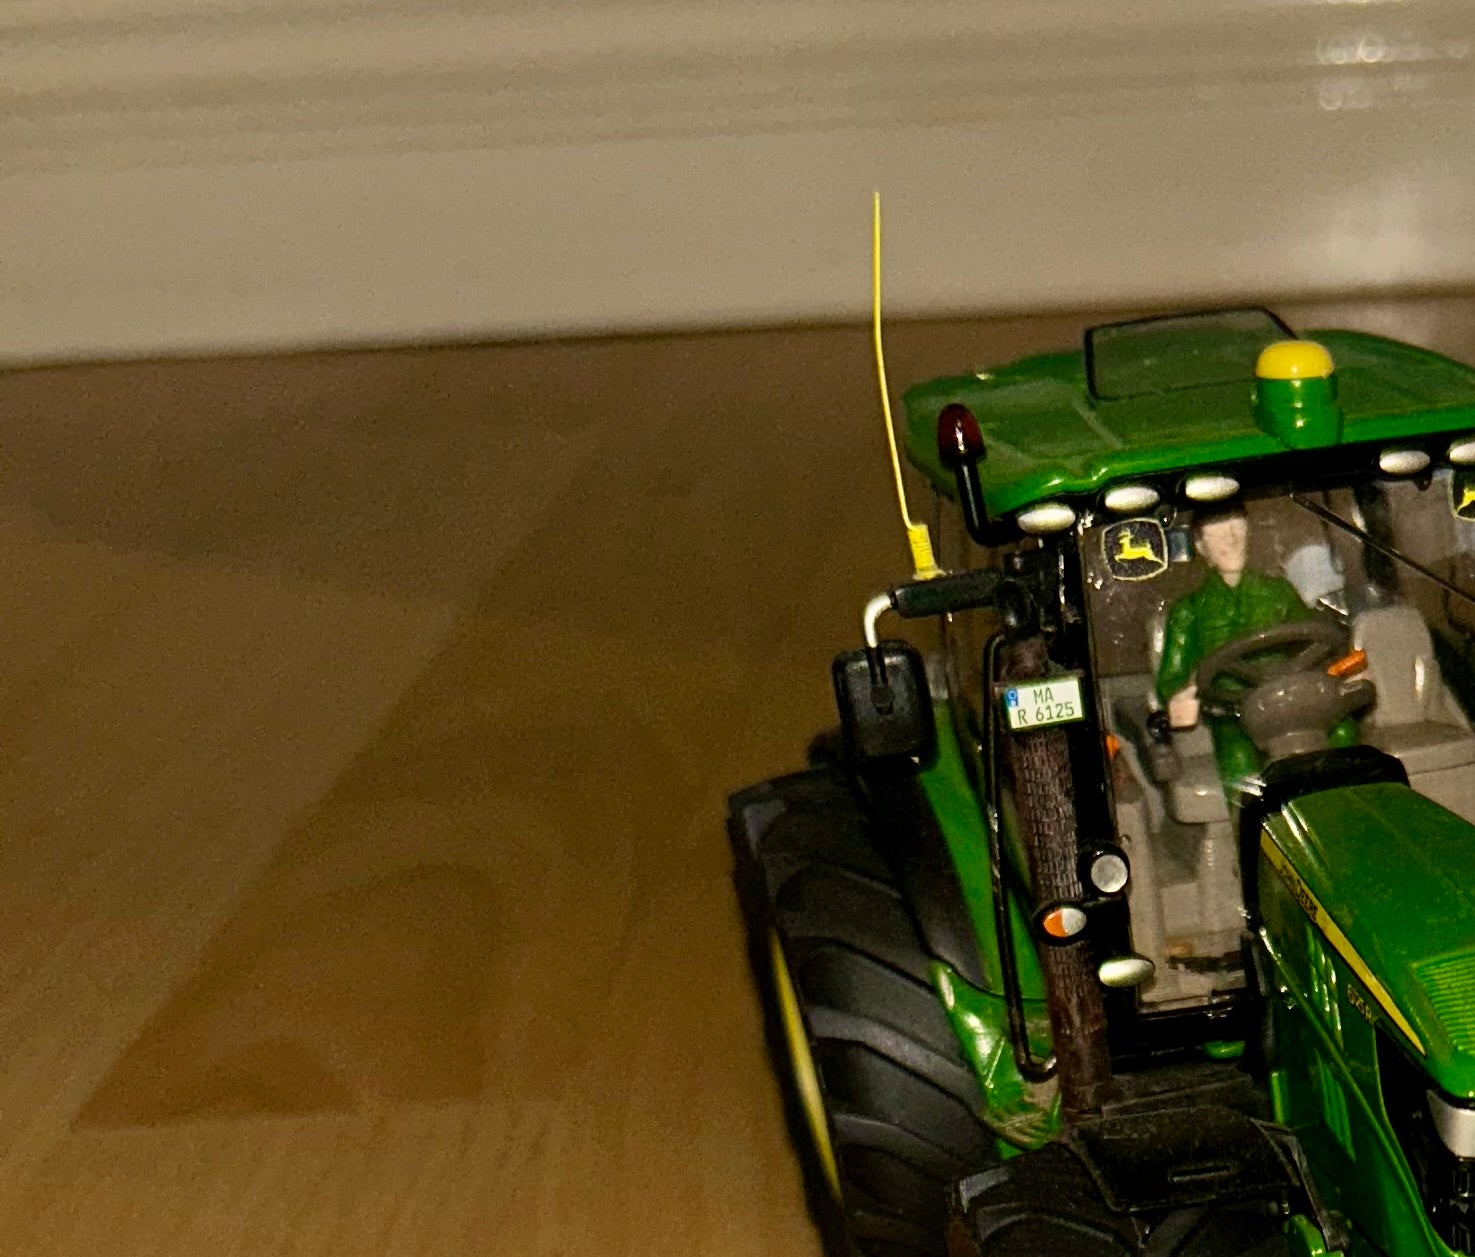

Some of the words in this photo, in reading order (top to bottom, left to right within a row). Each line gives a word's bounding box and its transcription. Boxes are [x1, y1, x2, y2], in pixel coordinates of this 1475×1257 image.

[1033, 686, 1054, 704] MA
[1017, 708, 1028, 725] R
[1035, 701, 1075, 721] 6125
